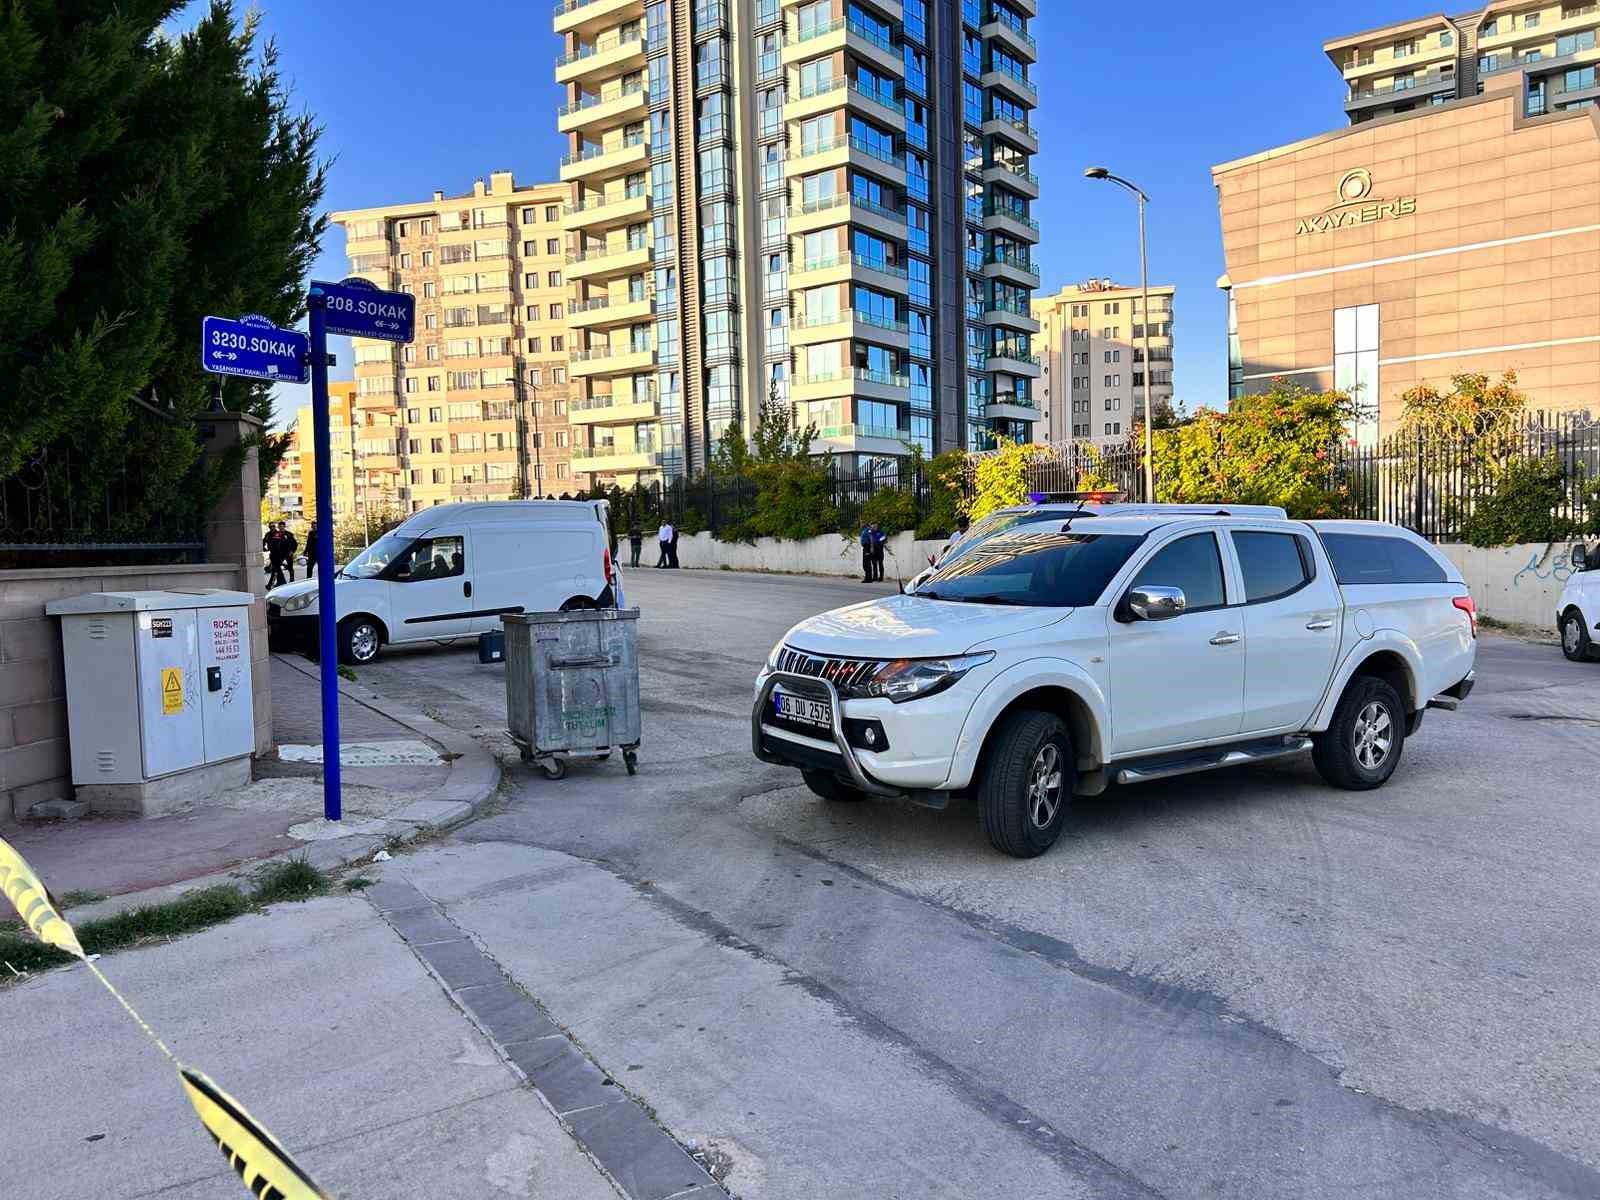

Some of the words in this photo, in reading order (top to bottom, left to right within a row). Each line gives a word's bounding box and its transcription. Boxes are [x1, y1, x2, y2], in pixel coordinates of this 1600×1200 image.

[327, 296, 407, 320] 208.SOKAK
[212, 330, 296, 358] 3230.SOKAK
[781, 696, 791, 712] 06
[796, 699, 806, 716] DU
[810, 702, 830, 721] 2575
